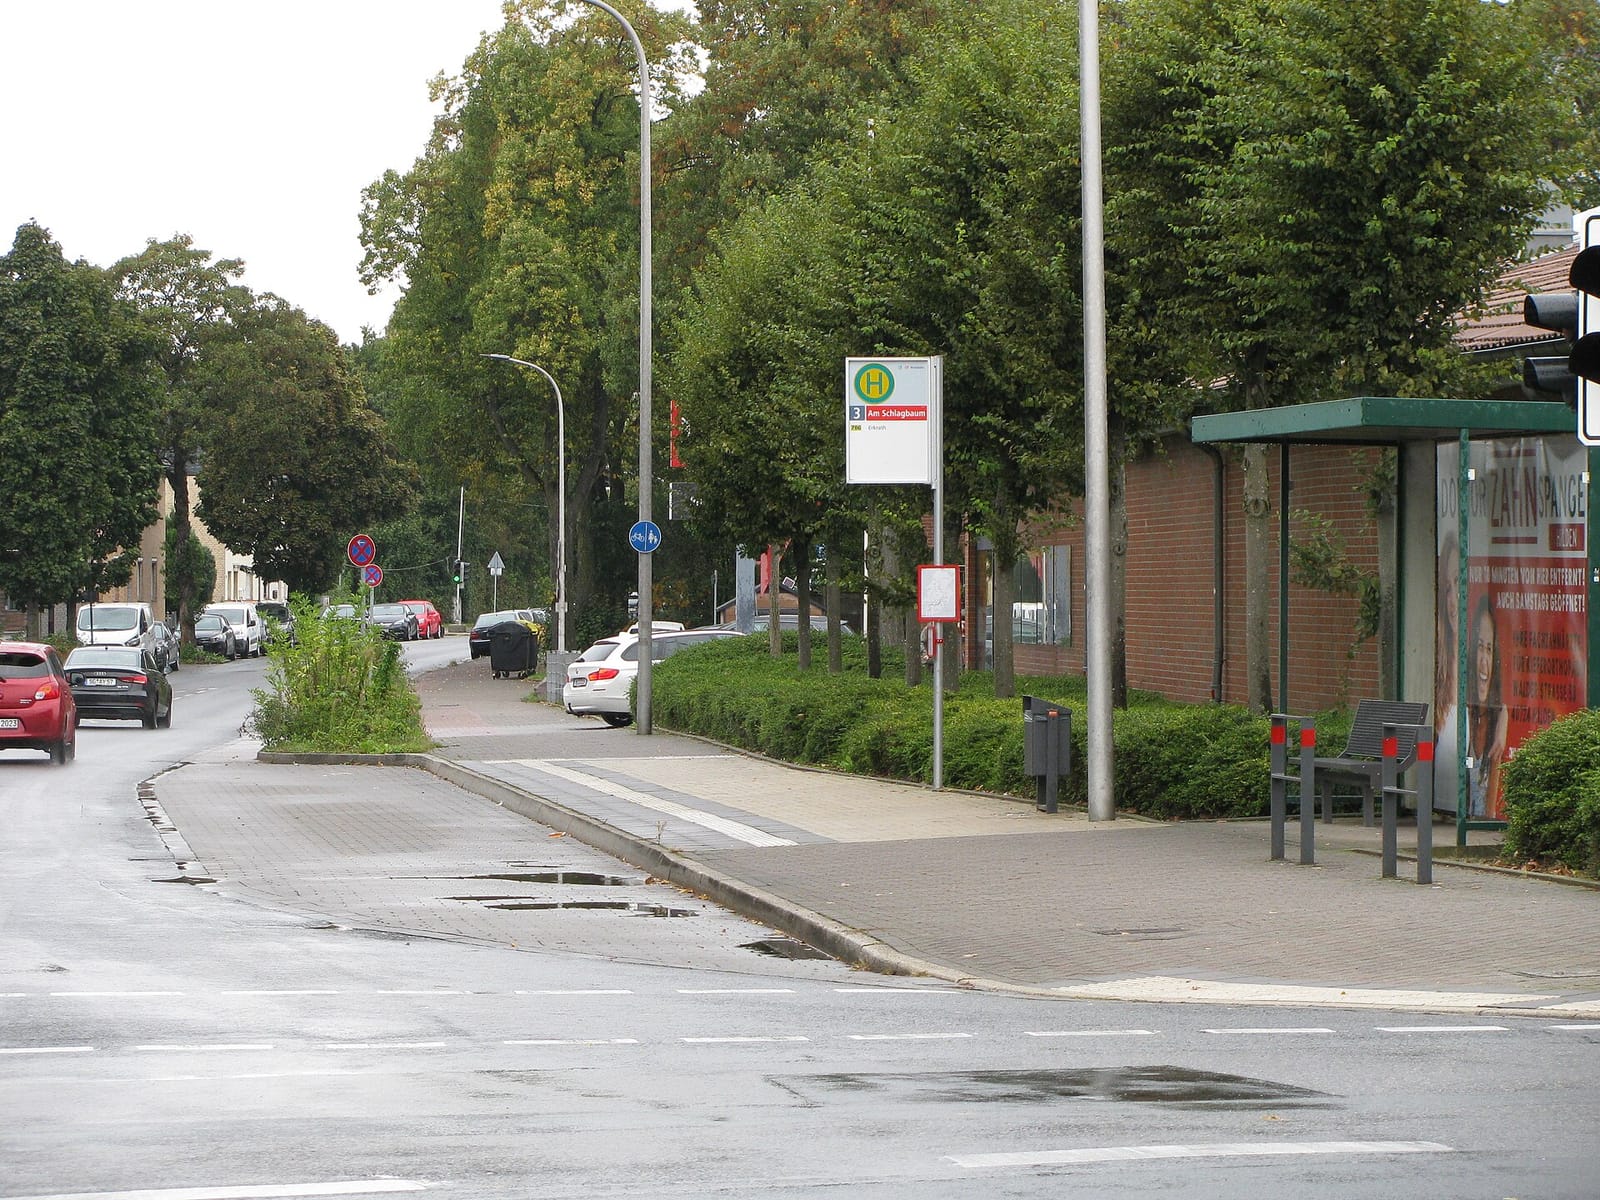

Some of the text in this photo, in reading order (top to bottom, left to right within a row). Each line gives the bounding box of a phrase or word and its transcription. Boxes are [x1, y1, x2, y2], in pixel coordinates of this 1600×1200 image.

[867, 372, 882, 394] H
[853, 407, 861, 420] 3
[882, 409, 926, 419] Schlagbaum
[1441, 467, 1585, 528] DOOR ZAHN SPANGE
[1520, 567, 1535, 585] VON
[1550, 567, 1586, 586] ENTFERNT!
[1496, 589, 1586, 612] AUCH SAMSTAGS GEÖFFNET!
[0, 719, 17, 727] 2023
